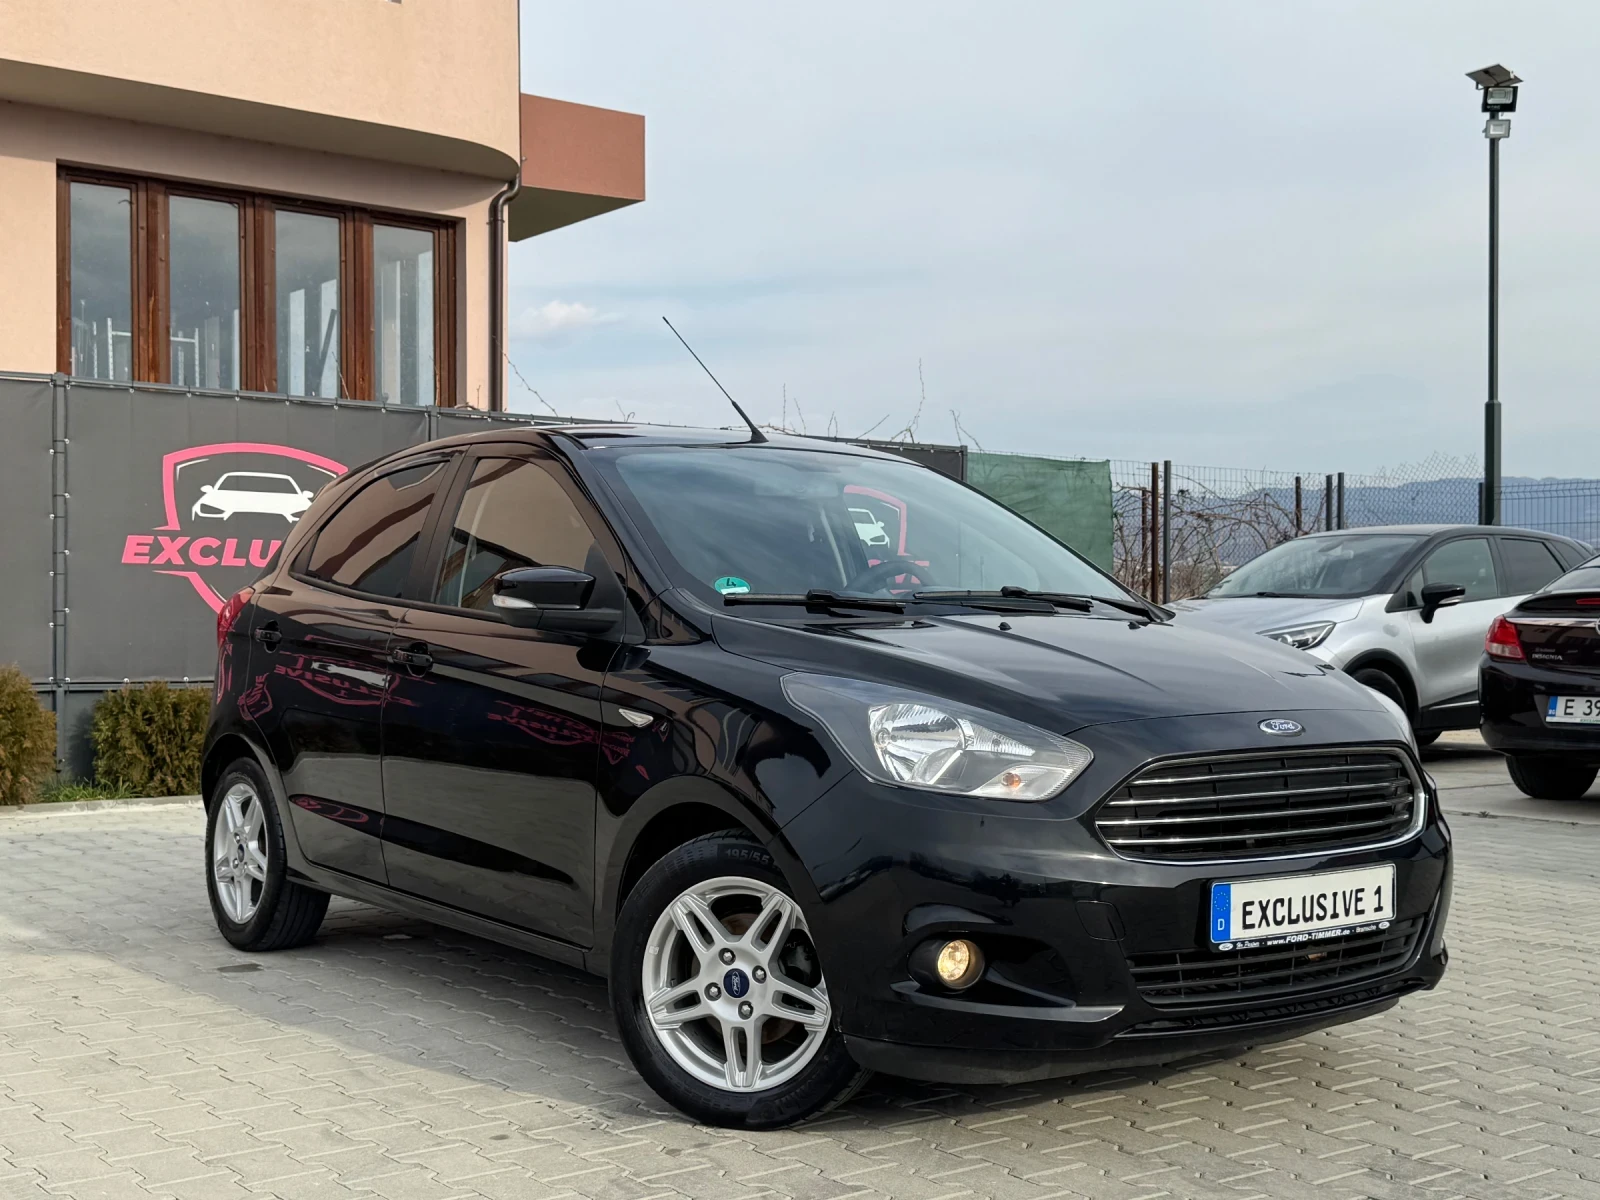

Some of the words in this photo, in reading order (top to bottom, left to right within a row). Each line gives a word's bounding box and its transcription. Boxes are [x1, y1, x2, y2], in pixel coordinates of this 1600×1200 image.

[121, 535, 282, 568] EXCLU
[726, 578, 736, 587] 4
[1564, 698, 1575, 716] E
[1270, 720, 1296, 730] Ford
[1242, 888, 1365, 930] EXCLUSIVE
[1373, 885, 1384, 913] 1
[1217, 918, 1225, 931] D
[1267, 928, 1350, 946] www.FORD-TIMMER.de
